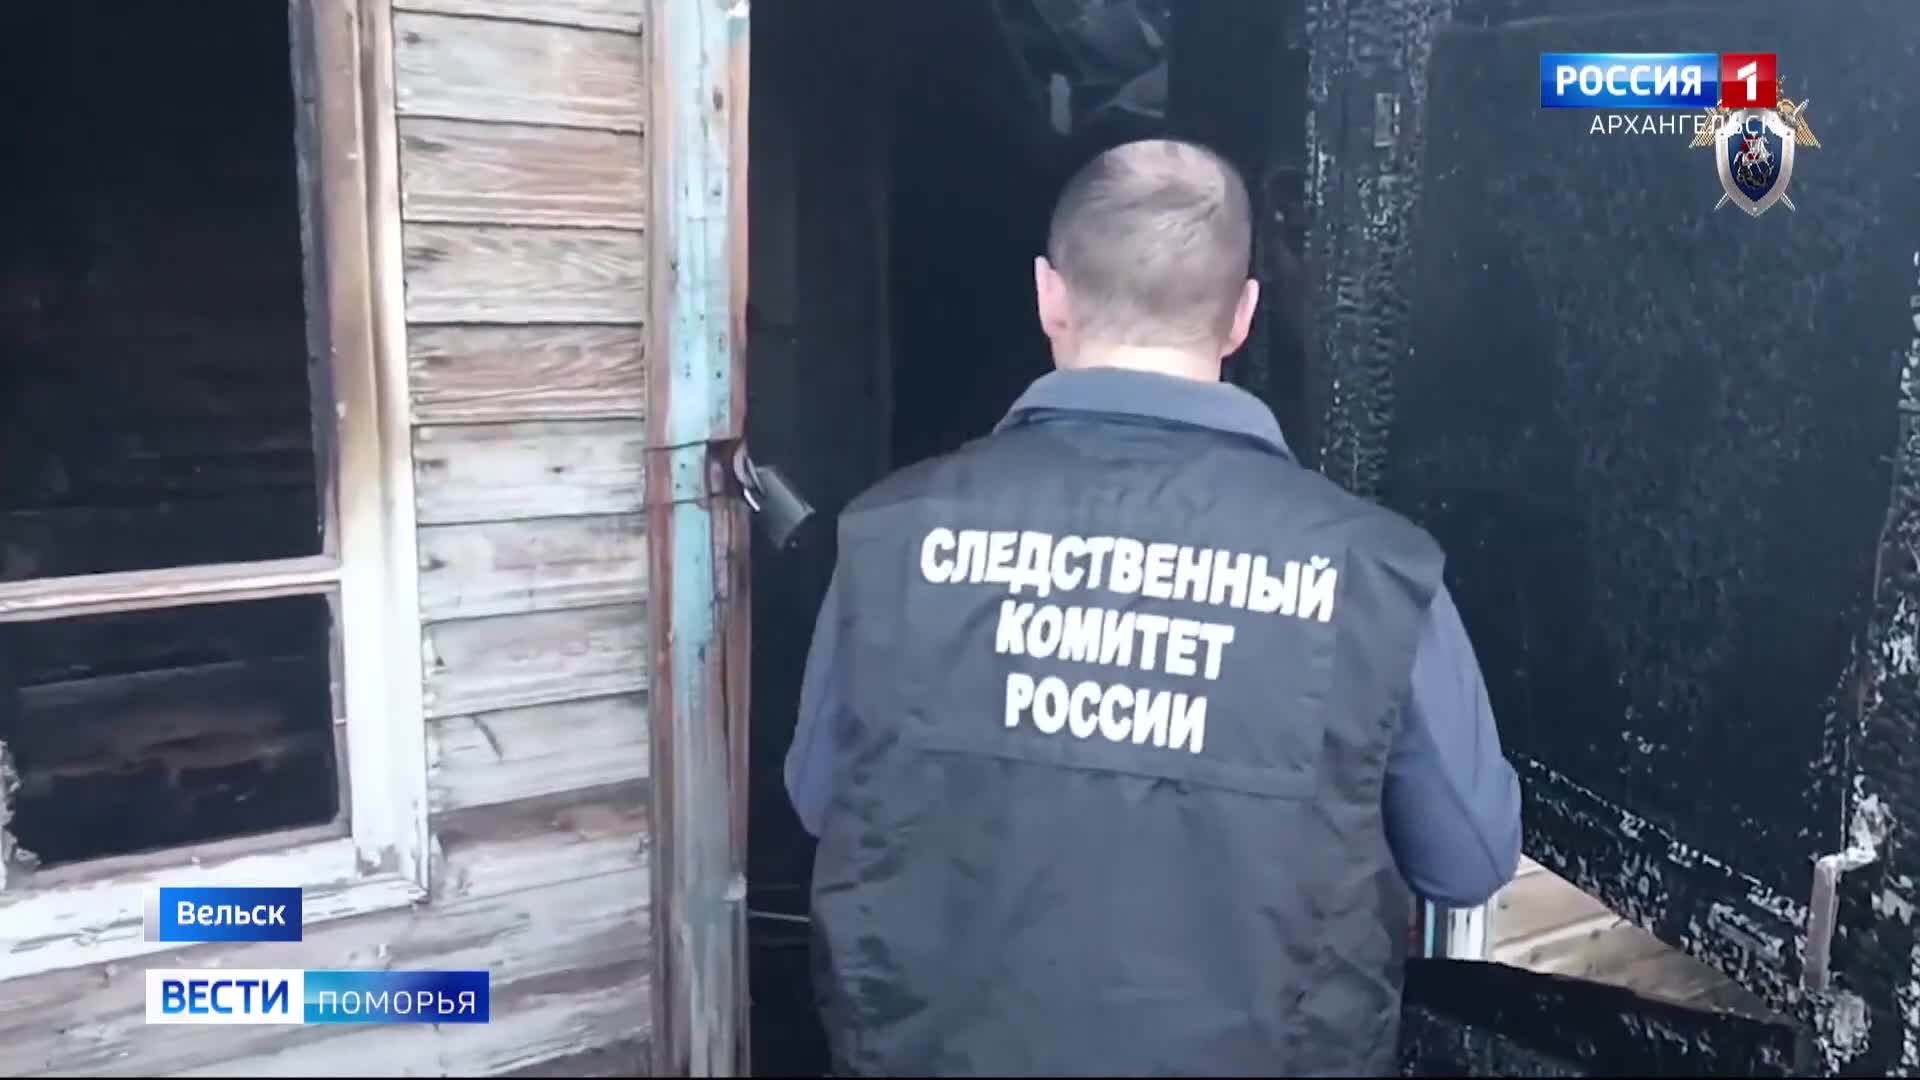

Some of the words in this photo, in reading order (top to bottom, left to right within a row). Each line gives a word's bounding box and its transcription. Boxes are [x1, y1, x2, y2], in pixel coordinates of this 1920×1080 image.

[920, 527, 1338, 622] СЛЕДСТВЕННЫЙ
[995, 600, 1235, 680] КОМИТЕТ
[1005, 672, 1207, 754] РОССИИ
